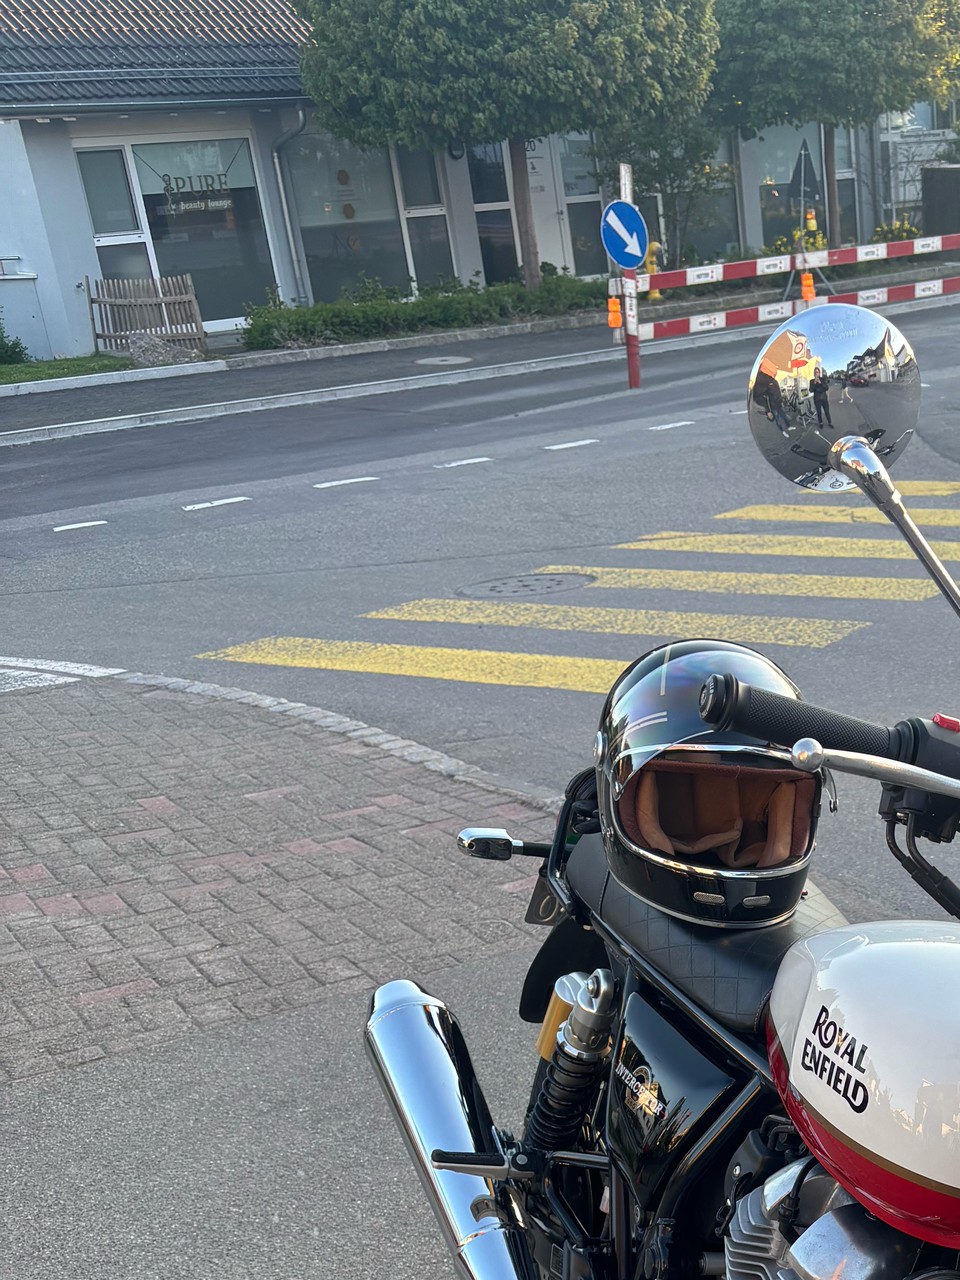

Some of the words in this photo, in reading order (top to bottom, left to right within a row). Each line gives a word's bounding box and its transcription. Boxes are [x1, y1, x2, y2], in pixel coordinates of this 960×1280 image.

[173, 174, 230, 197] PURE
[181, 201, 205, 210] beauty
[208, 199, 232, 208] lounge
[812, 1005, 868, 1074] ROYAL
[615, 1062, 663, 1116] INTERCEPTOR
[801, 1037, 869, 1114] ENFIELD
